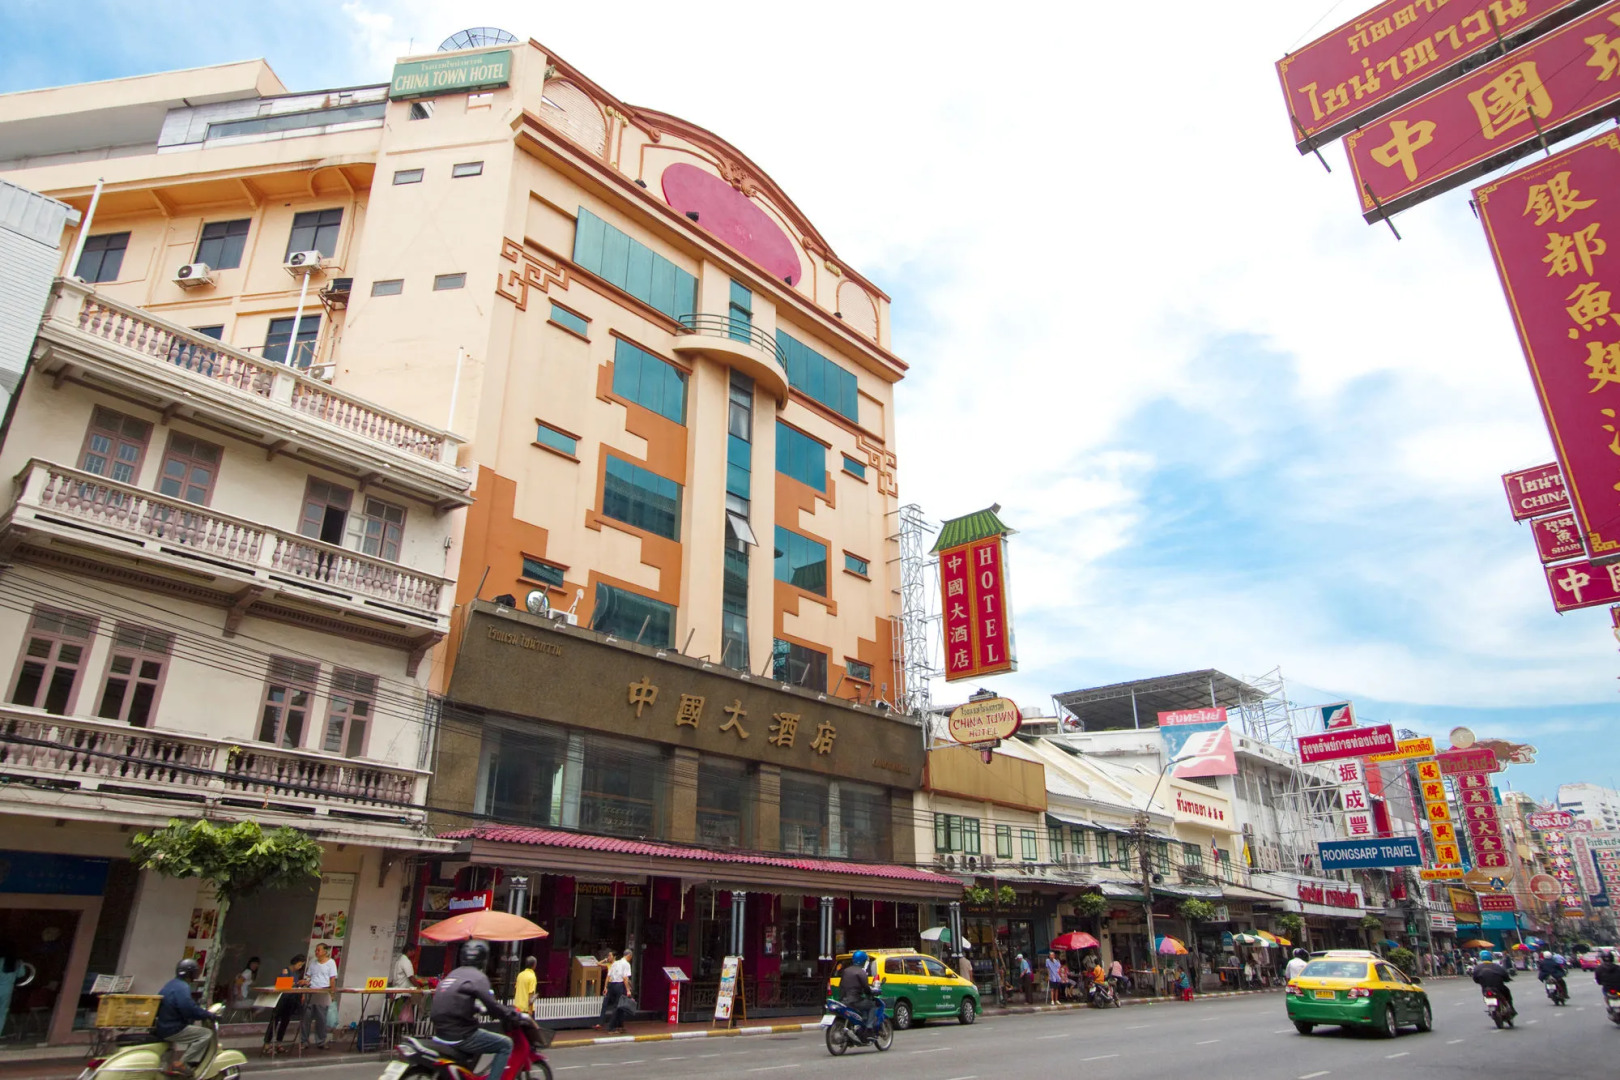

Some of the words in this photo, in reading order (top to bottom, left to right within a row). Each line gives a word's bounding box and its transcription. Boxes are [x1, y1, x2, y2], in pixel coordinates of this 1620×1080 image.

[395, 73, 429, 91] CHINA
[433, 68, 468, 86] TOWN
[469, 63, 504, 81] HOTEL
[1514, 472, 1565, 494] ไชน่า
[947, 555, 970, 670] 中國大酒店
[978, 546, 999, 664] HOTEL
[628, 675, 838, 755] 中國大酒店
[953, 716, 983, 730] CHINA
[986, 710, 1014, 725] TOWN
[969, 727, 999, 738] HOTEL
[1338, 763, 1371, 835] 振成豐
[1322, 847, 1378, 861] ROONGSARP
[1380, 845, 1417, 859] TRAVEL
[367, 978, 385, 988] 100
